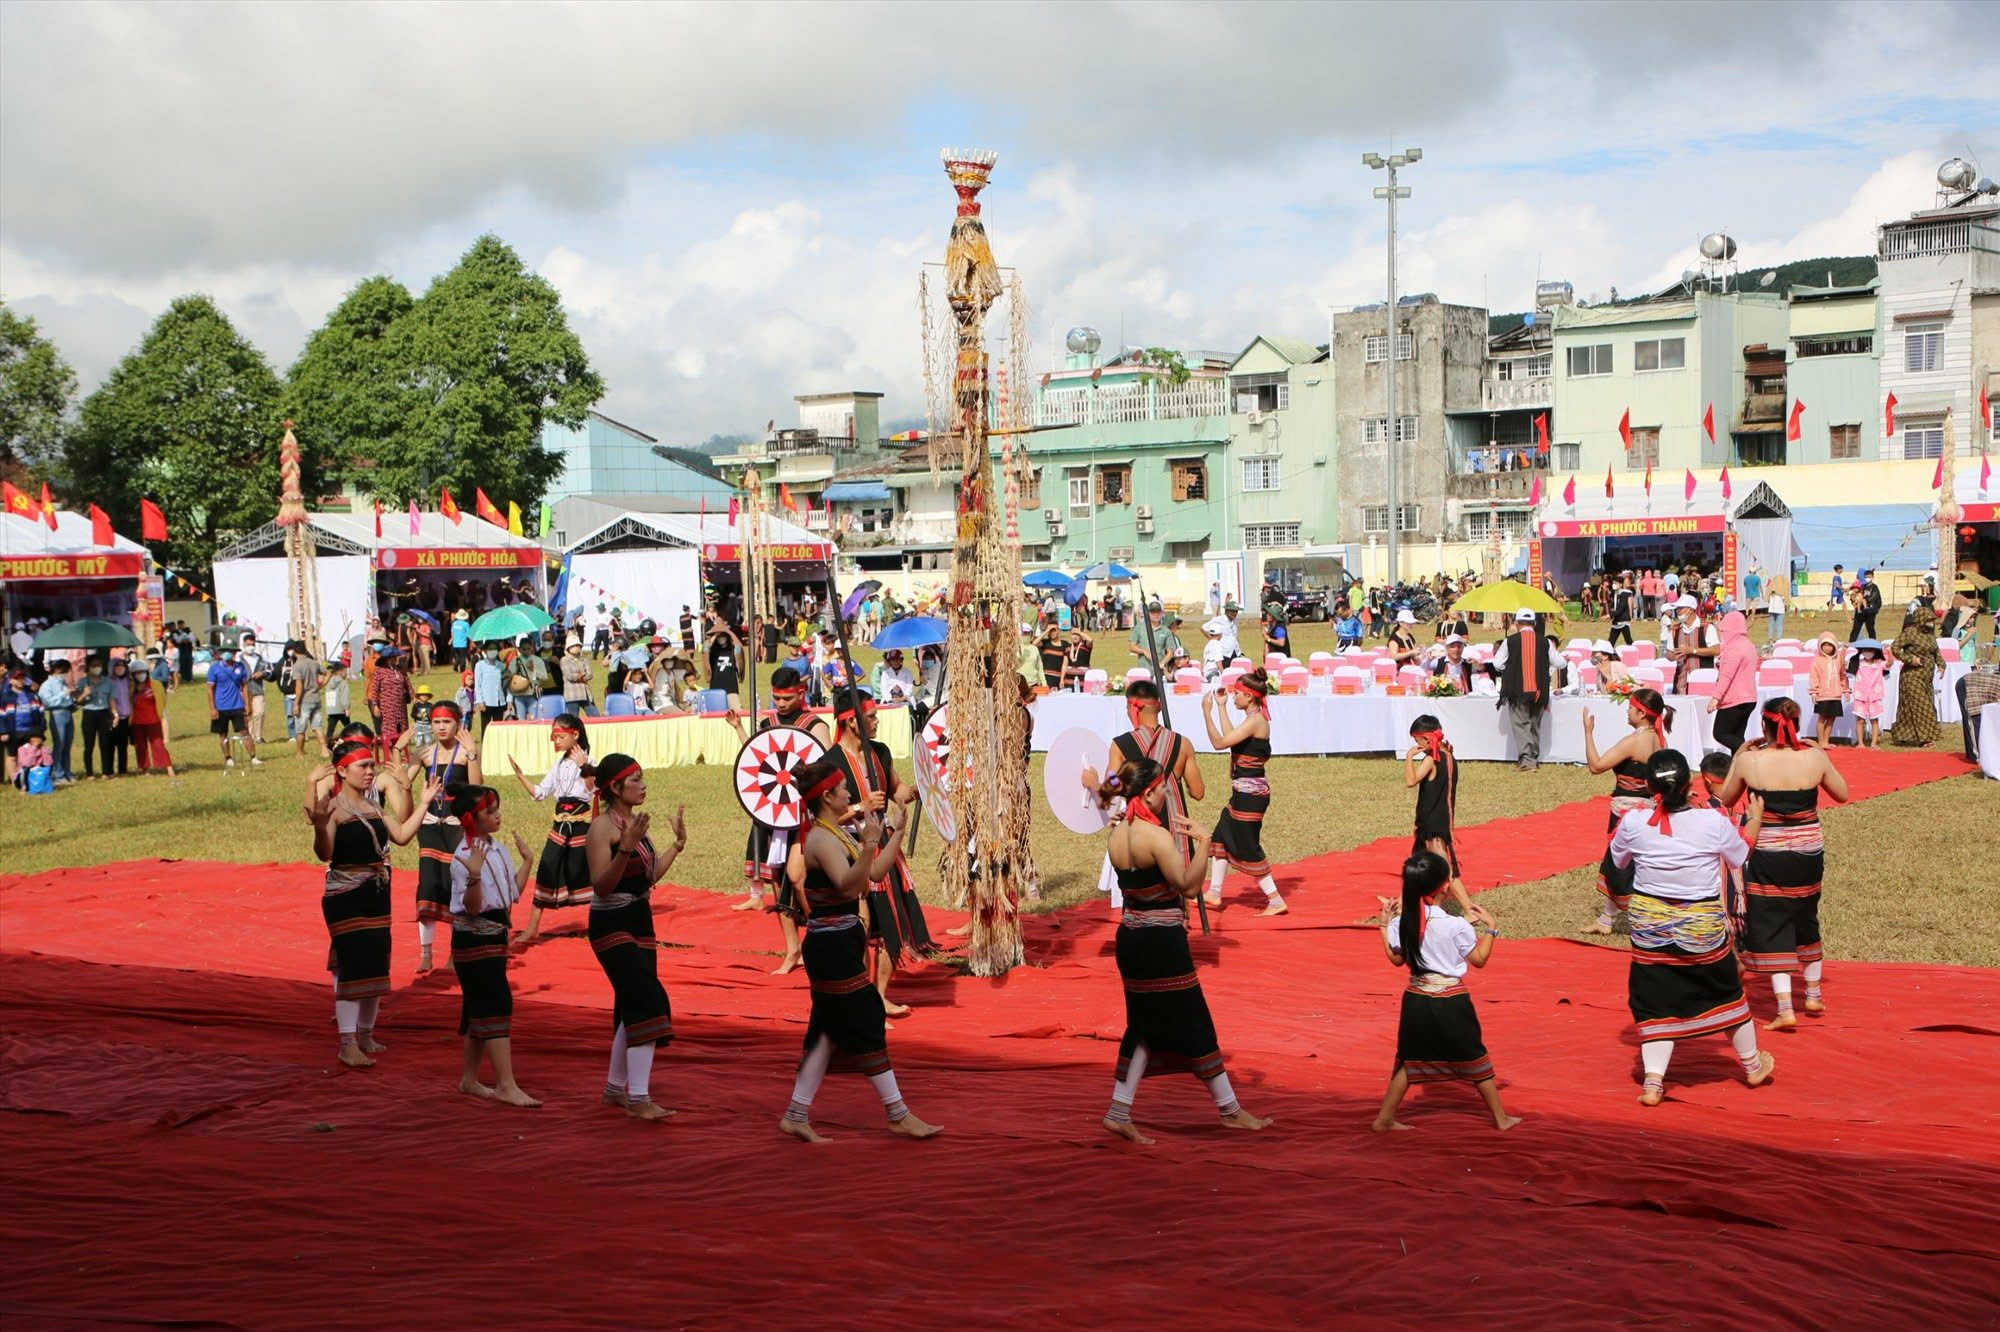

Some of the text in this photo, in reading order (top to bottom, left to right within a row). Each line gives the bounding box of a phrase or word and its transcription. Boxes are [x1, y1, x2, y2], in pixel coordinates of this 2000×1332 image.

[1579, 519, 1697, 535] XÃ PHƯỚC THÀNH
[417, 550, 518, 566] XÃ PHƯỚC HÒA
[792, 544, 813, 559] LỘC
[0, 557, 108, 576] PHƯỚC MỸ
